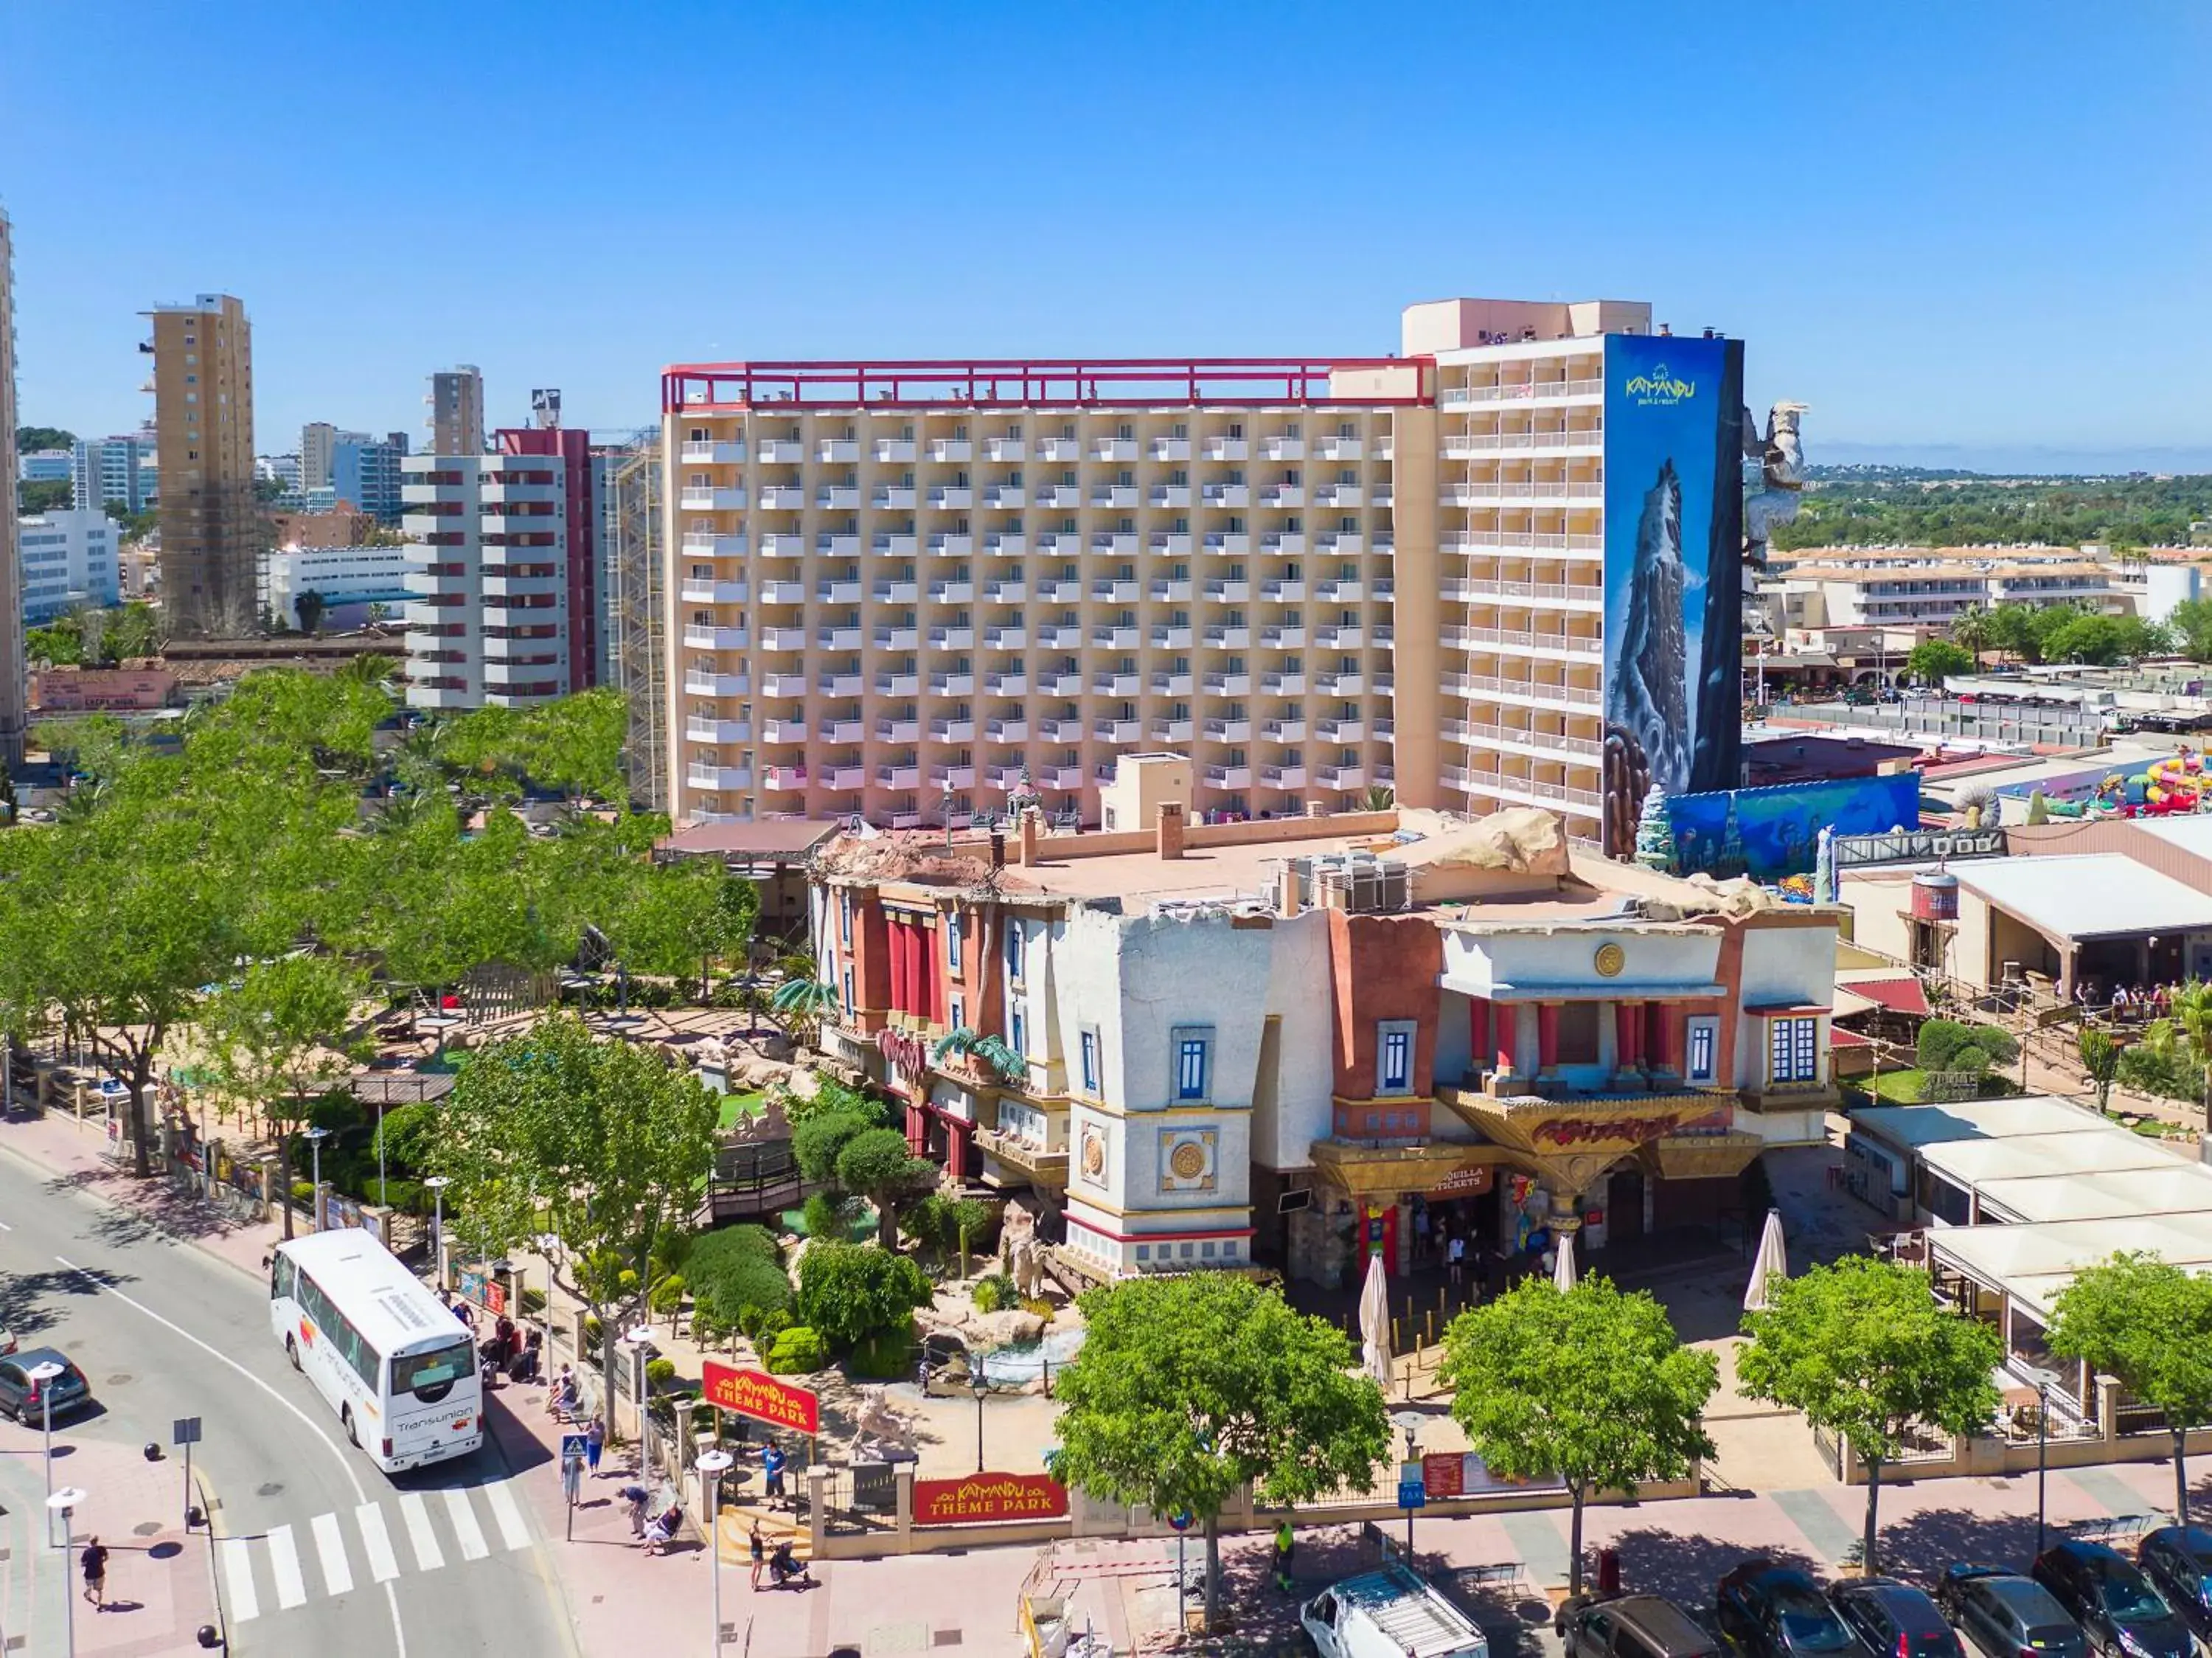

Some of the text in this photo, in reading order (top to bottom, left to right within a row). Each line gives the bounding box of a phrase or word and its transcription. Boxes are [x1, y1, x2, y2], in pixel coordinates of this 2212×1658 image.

[714, 1385, 807, 1426] THEME PARK
[397, 1406, 473, 1432] Transunion
[930, 1497, 1053, 1515] THEME PARK
[1402, 1491, 1424, 1500] TAXI
